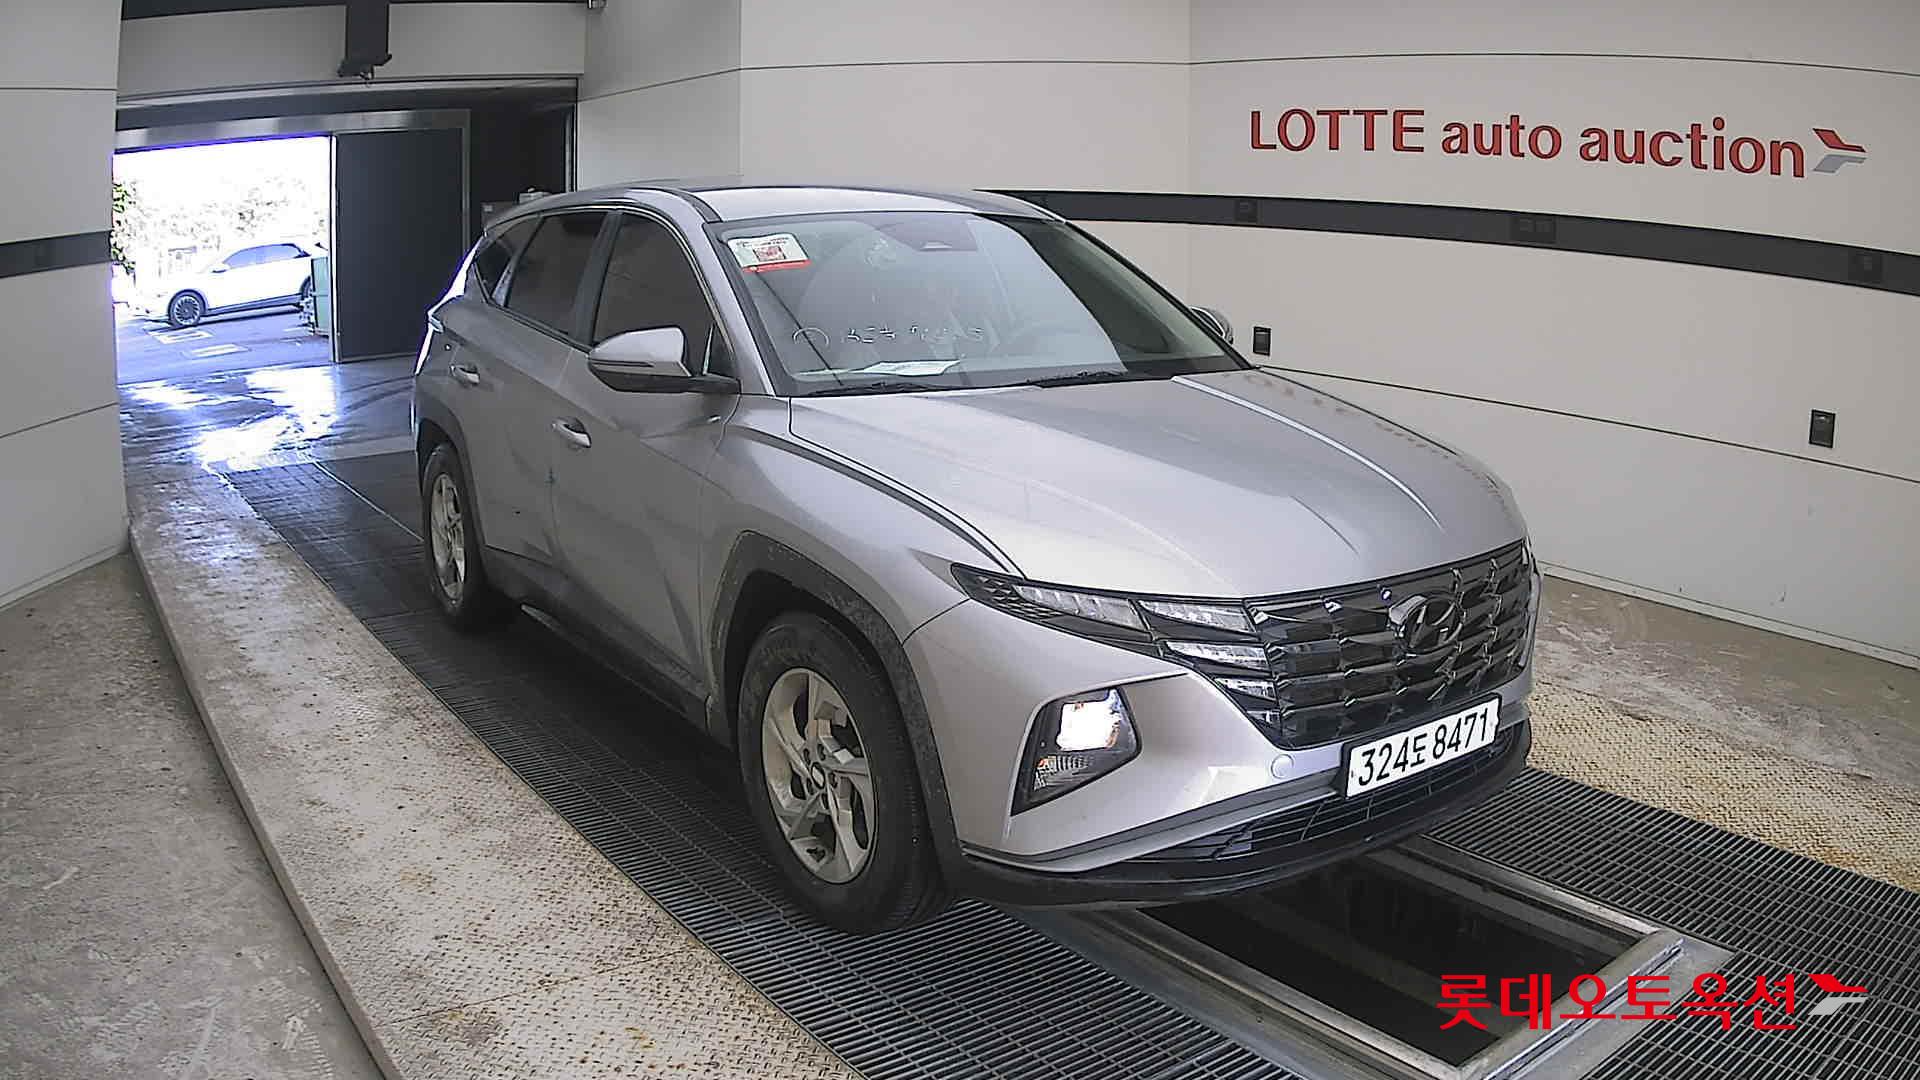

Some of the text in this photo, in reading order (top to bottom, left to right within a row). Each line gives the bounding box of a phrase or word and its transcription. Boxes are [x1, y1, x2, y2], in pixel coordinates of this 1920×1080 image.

[1250, 108, 1806, 178] LOTTE auto auction
